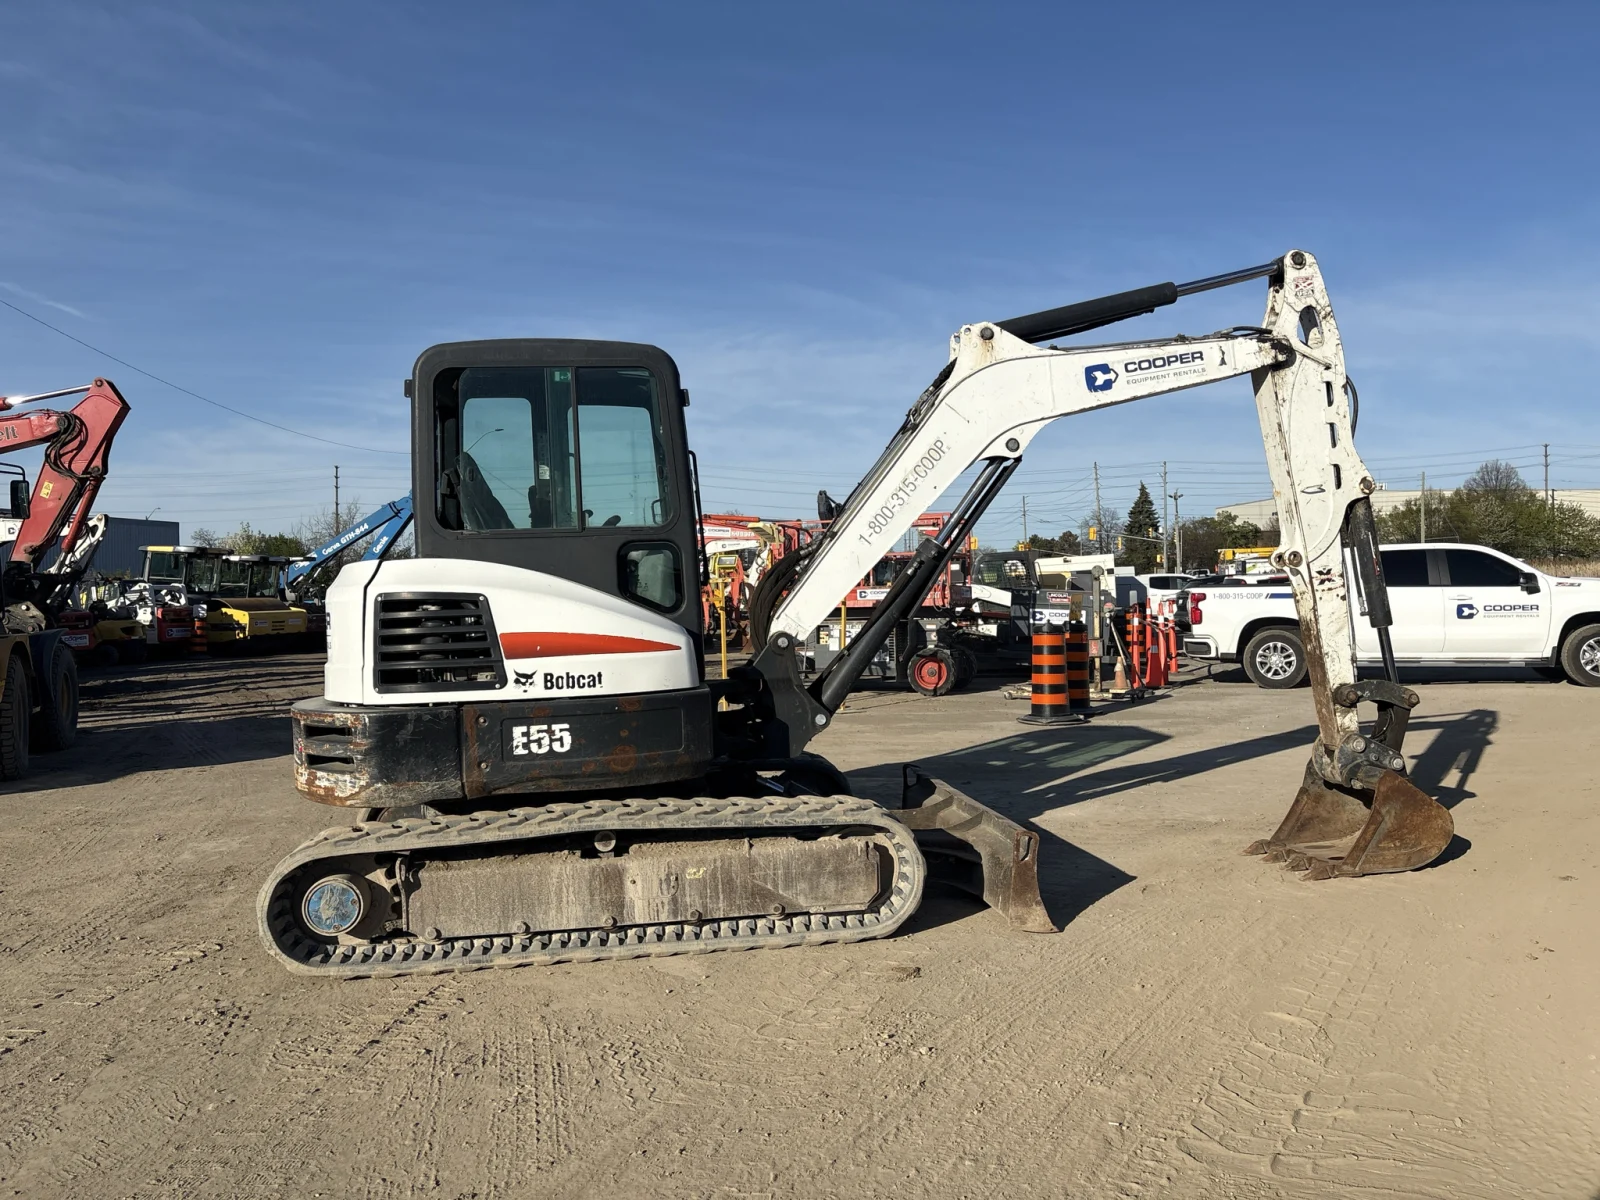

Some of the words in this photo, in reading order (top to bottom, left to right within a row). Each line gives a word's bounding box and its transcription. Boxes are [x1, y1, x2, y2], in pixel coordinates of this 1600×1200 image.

[1124, 350, 1204, 373] COOPER
[1126, 373, 1170, 385] EQUIPMENT
[1173, 367, 1206, 378] RENTALS
[1213, 592, 1264, 600] 1-800-315-COOP
[1483, 604, 1540, 612] COOPER
[543, 671, 604, 690] Bobcat
[512, 723, 572, 755] E55
